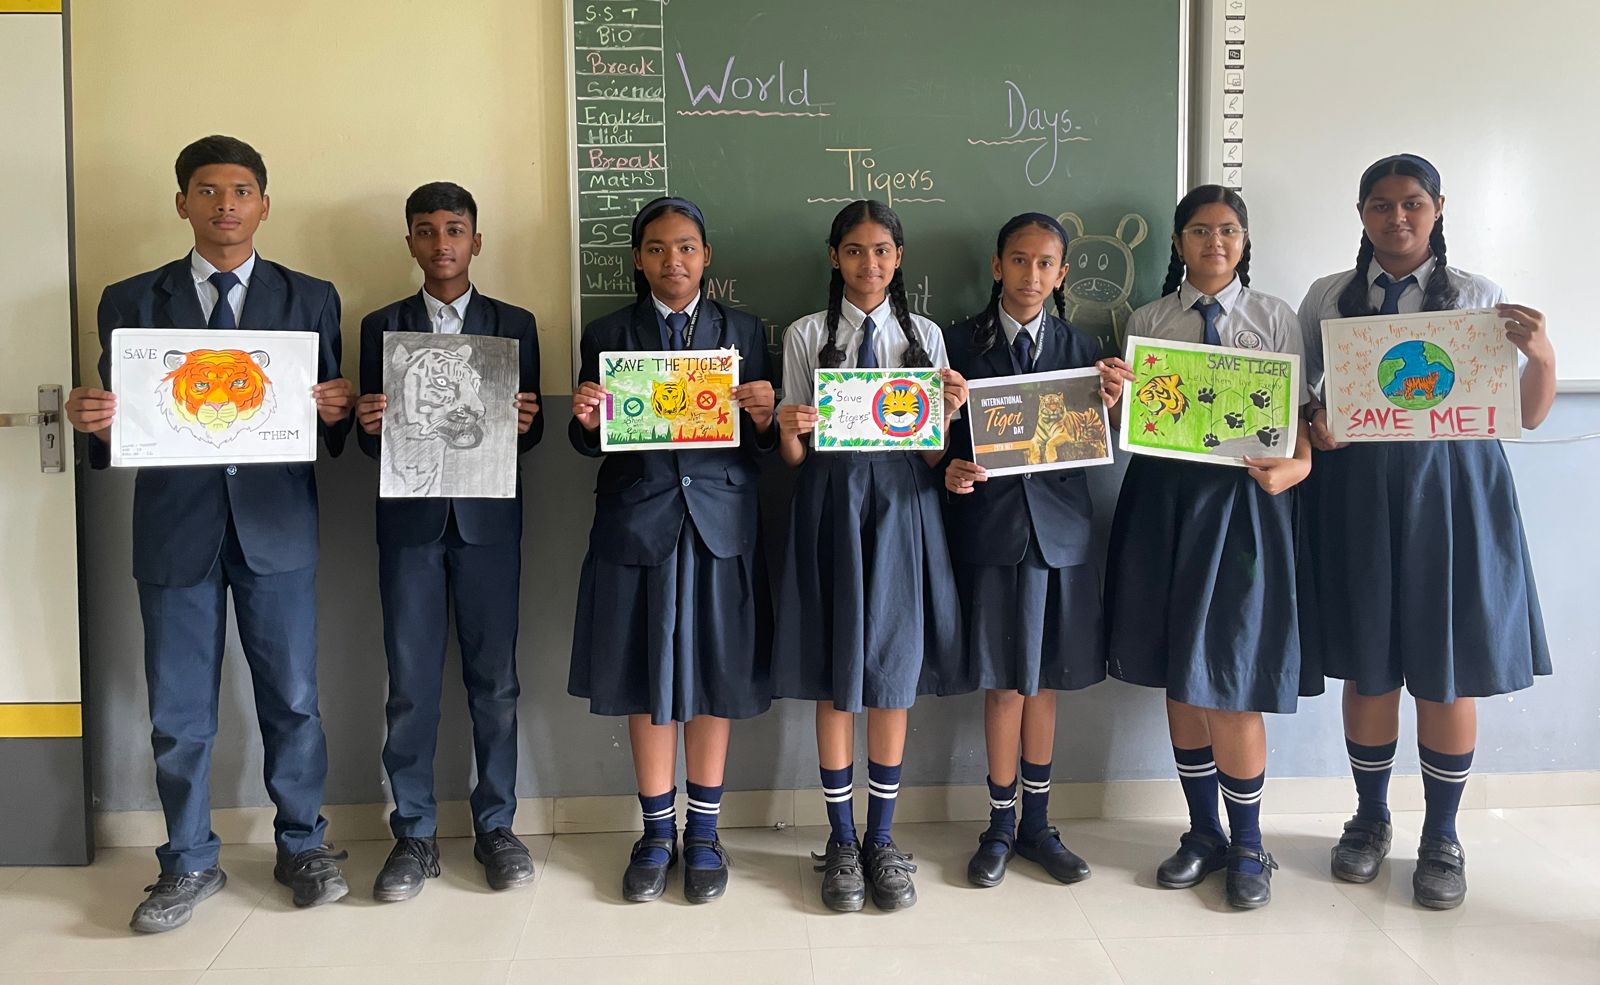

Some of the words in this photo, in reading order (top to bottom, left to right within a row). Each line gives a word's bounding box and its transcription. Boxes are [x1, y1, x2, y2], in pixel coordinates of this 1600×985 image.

[587, 52, 655, 75] Break
[588, 80, 662, 98] Science
[676, 52, 810, 106] World
[585, 106, 650, 133] English
[589, 128, 632, 144] Hindi
[589, 149, 662, 169] Break
[825, 148, 933, 207] Tigers
[581, 251, 623, 277] Diary
[586, 273, 635, 293] Writi
[706, 278, 740, 303] AVE
[123, 349, 157, 360] SAVE
[614, 358, 645, 372] SAVE
[652, 357, 680, 372] THE
[683, 357, 730, 372] TIGER
[1207, 354, 1241, 372] SAVE
[1245, 360, 1288, 378] TIGER
[980, 394, 1023, 407] INTERNATIONAL
[984, 406, 1024, 436] Tiger
[1346, 407, 1414, 431] SAVE
[258, 430, 300, 441] THEM
[1013, 426, 1024, 435] DAY
